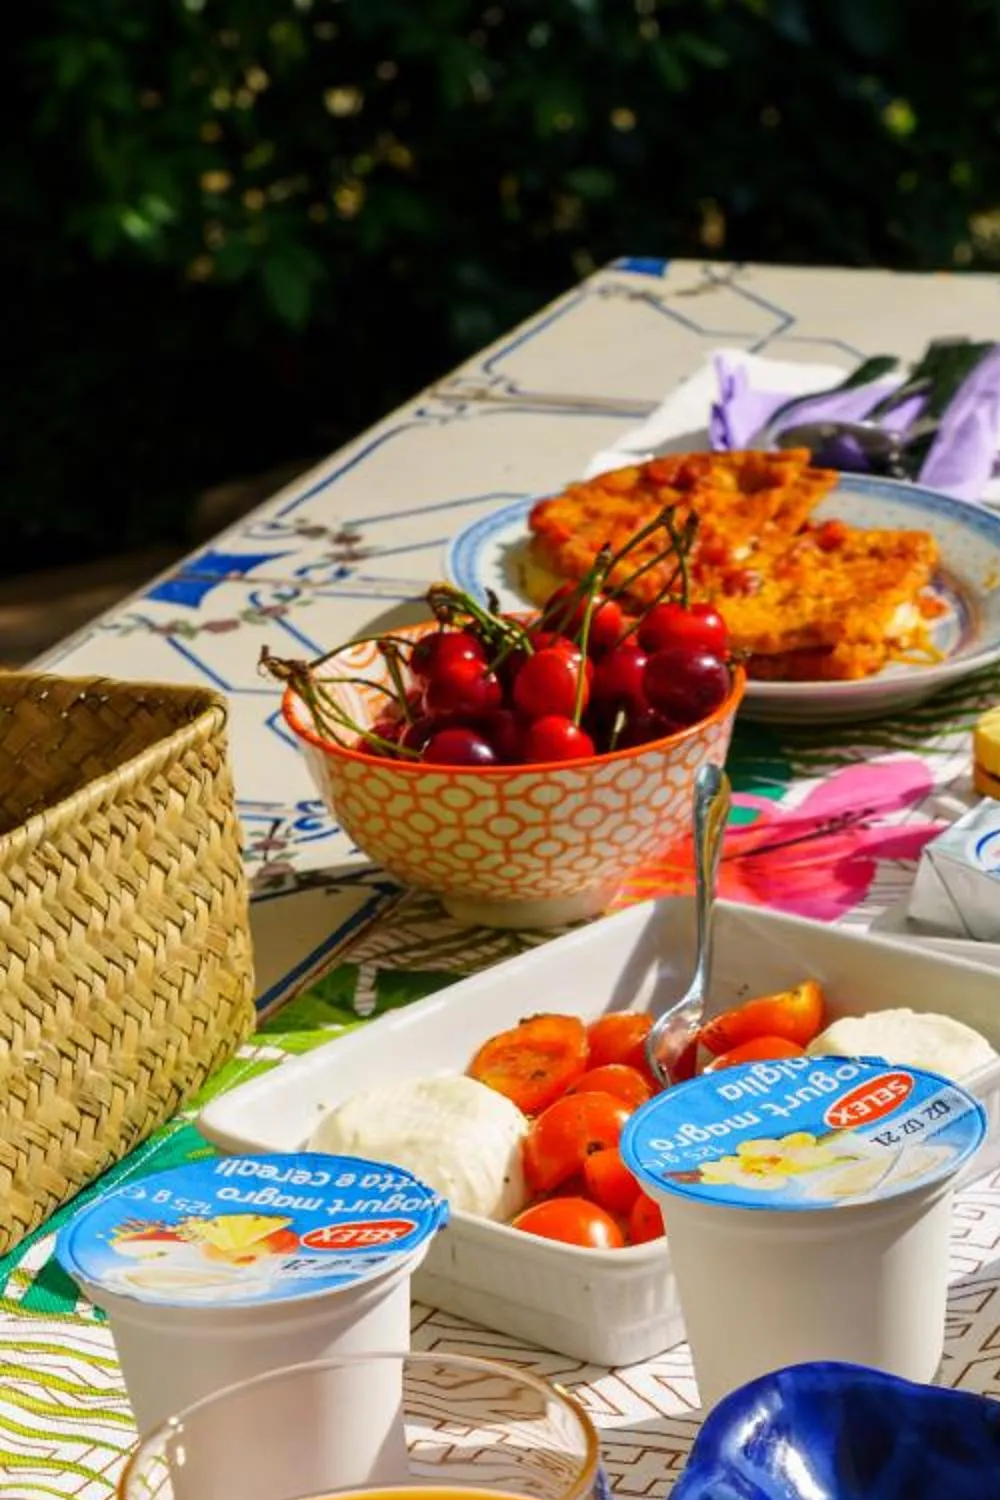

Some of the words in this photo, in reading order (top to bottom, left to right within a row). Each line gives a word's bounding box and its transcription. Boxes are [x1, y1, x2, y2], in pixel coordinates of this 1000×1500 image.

[717, 1056, 818, 1102] niglia
[829, 1079, 910, 1126] SELEX
[648, 1109, 762, 1151] magro
[215, 1158, 328, 1186] cereali
[335, 1172, 355, 1188] e
[216, 1186, 325, 1214] magro
[314, 1225, 407, 1244] SELEX
